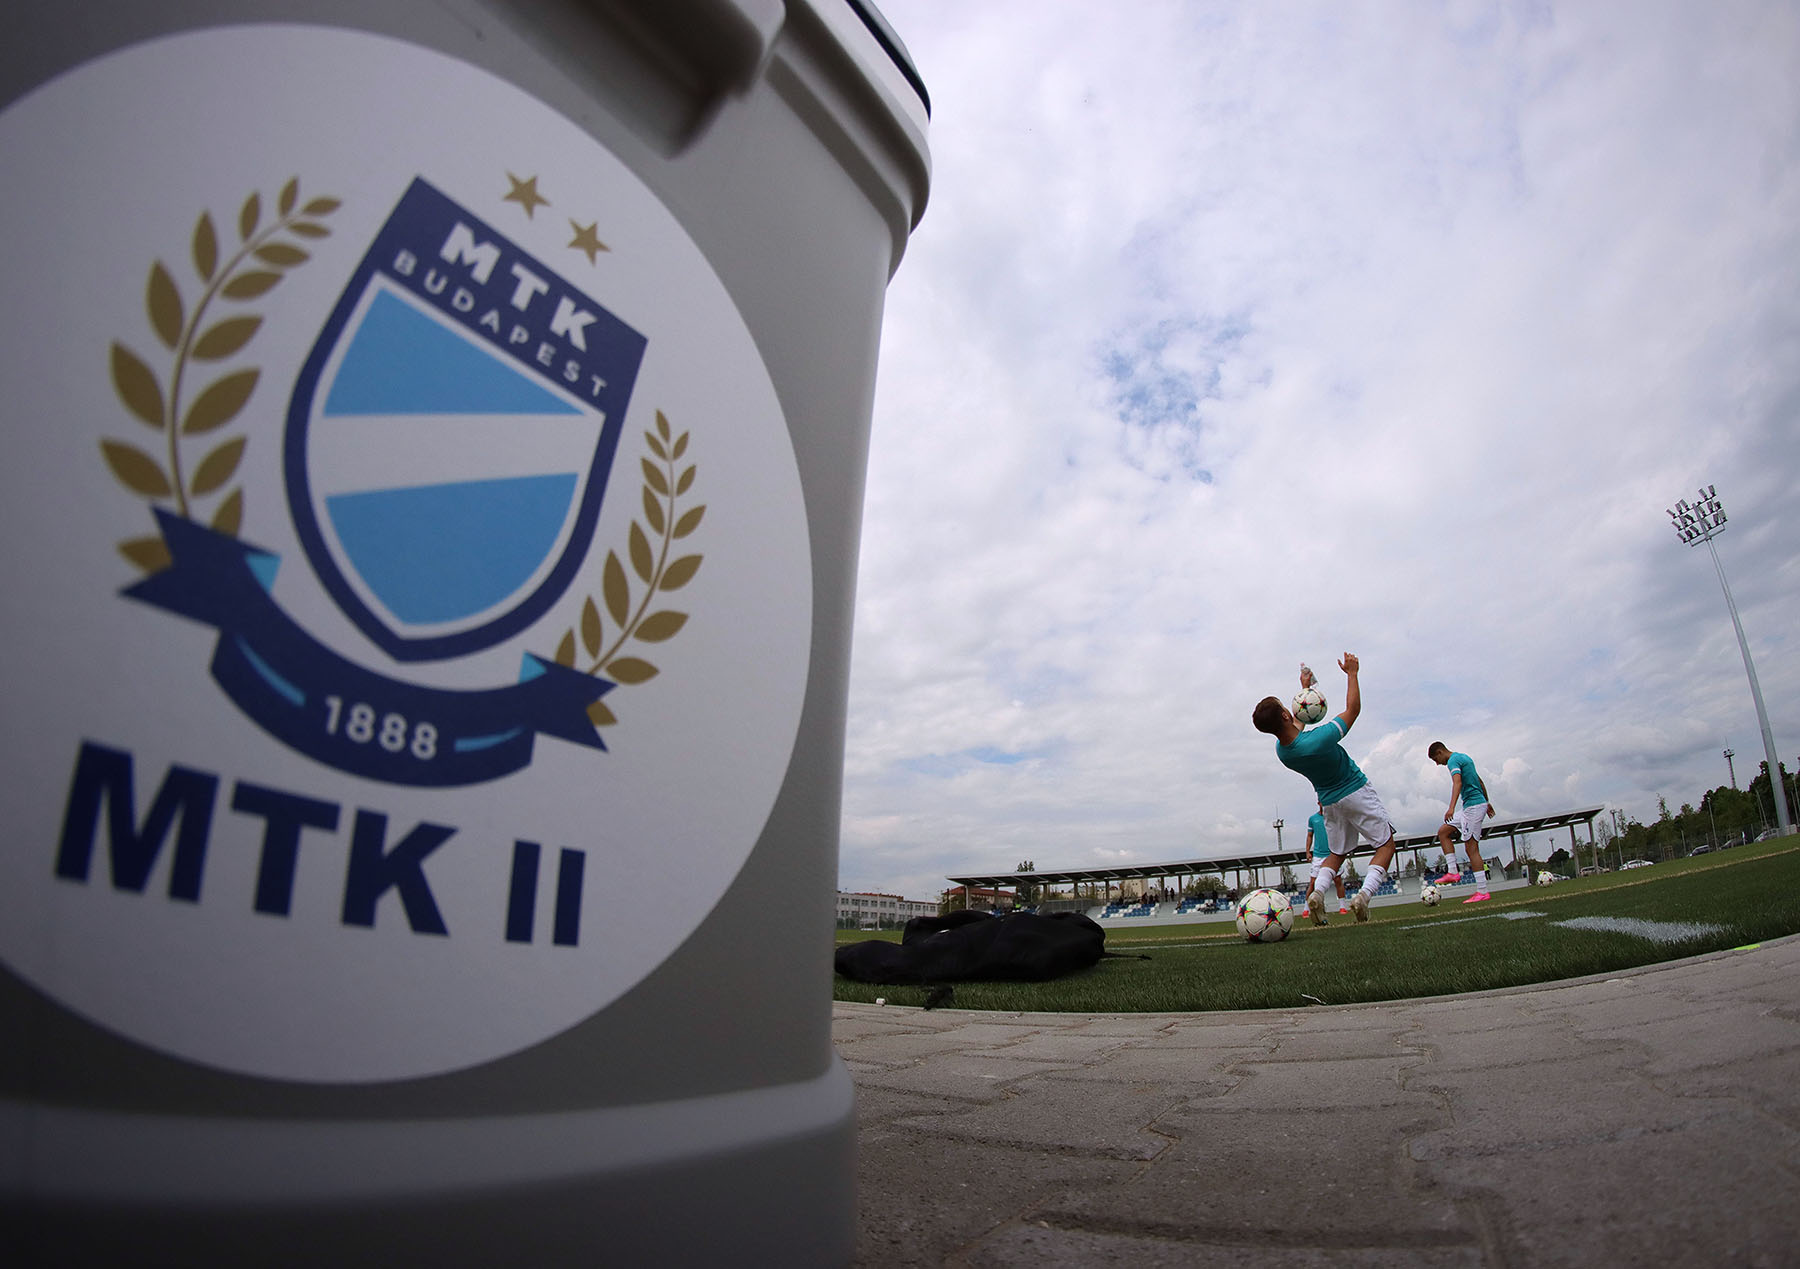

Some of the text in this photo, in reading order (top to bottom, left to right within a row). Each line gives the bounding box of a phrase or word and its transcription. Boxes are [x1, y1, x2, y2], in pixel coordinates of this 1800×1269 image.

[393, 249, 607, 397] BUDAPEST
[440, 222, 598, 351] MTK
[325, 696, 438, 760] 1888
[55, 739, 586, 947] MTK II
